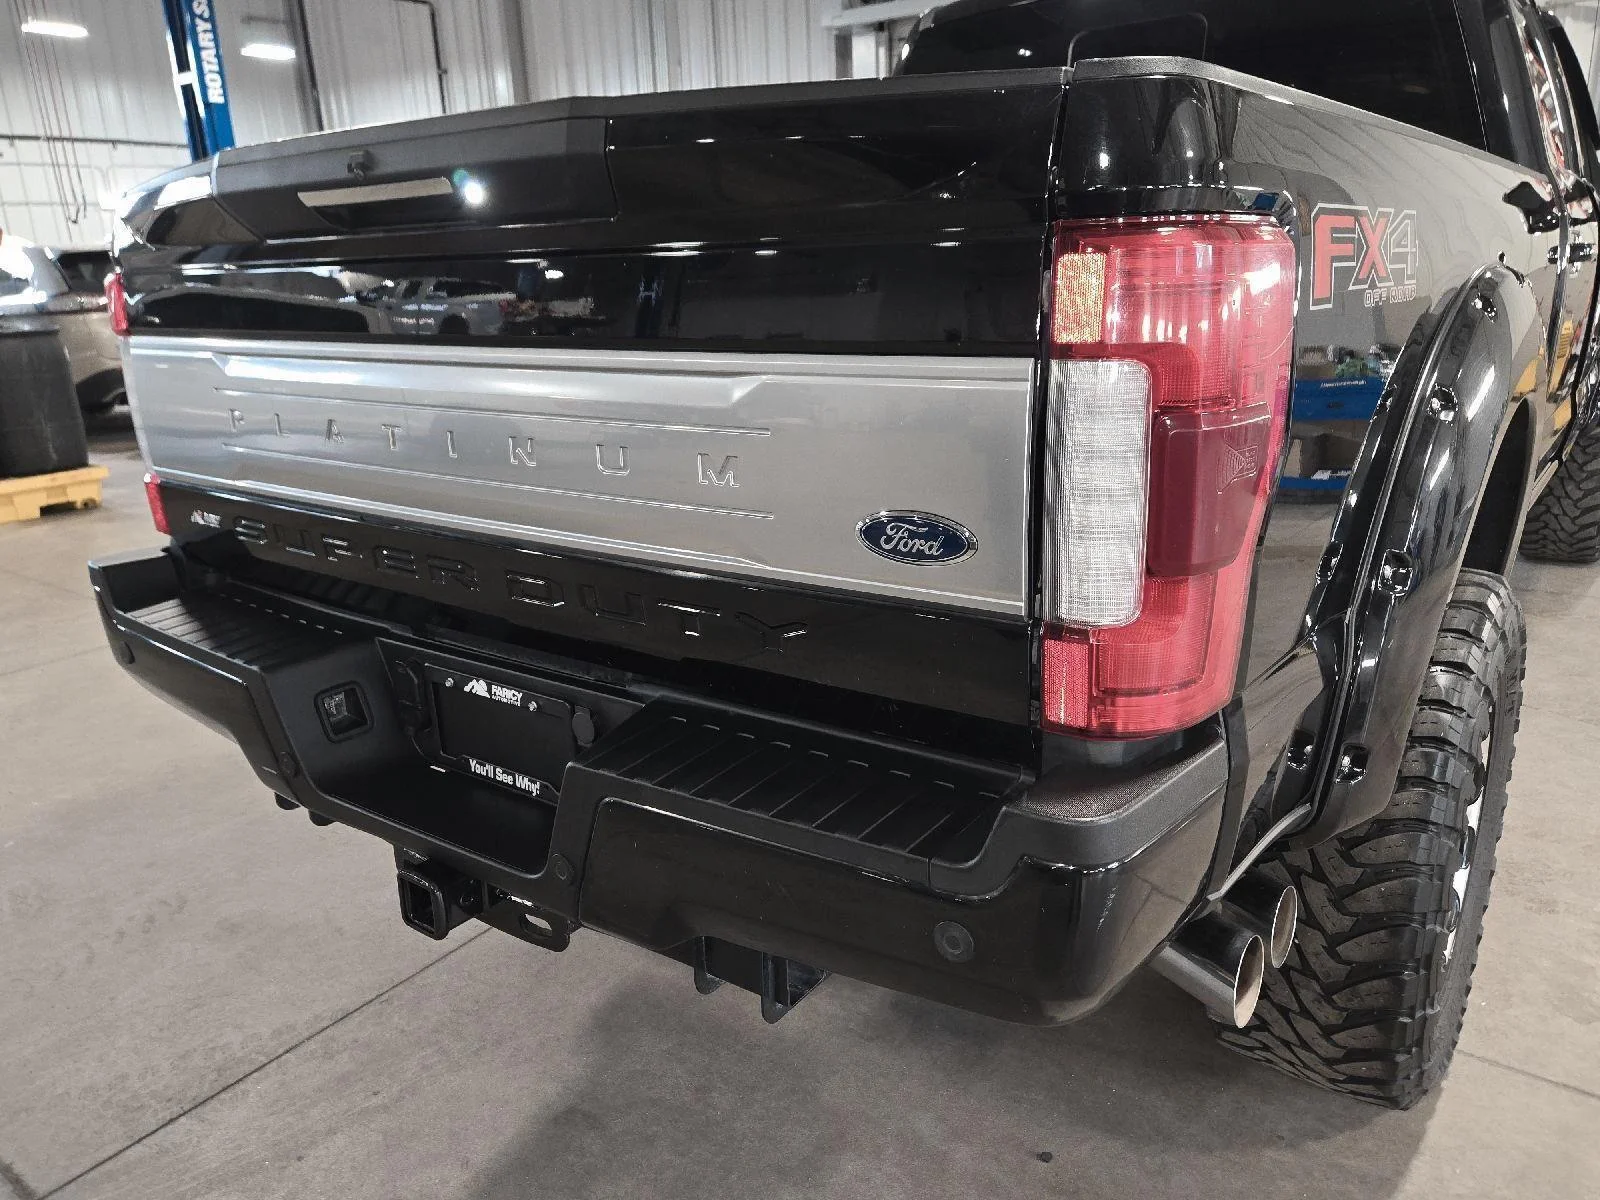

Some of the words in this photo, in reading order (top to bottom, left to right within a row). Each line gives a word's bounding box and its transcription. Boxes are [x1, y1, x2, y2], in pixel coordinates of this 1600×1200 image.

[195, 17, 225, 104] ROTARY
[1310, 202, 1418, 310] FX4
[1364, 288, 1388, 307] OFF
[1389, 284, 1417, 303] ROAD
[228, 408, 740, 488] PLATINUM
[879, 522, 945, 556] Ford
[232, 515, 481, 592] SUPER
[504, 568, 809, 654] DUTY
[469, 758, 494, 779] You'll
[495, 767, 514, 785] See
[515, 773, 540, 797] Why!
